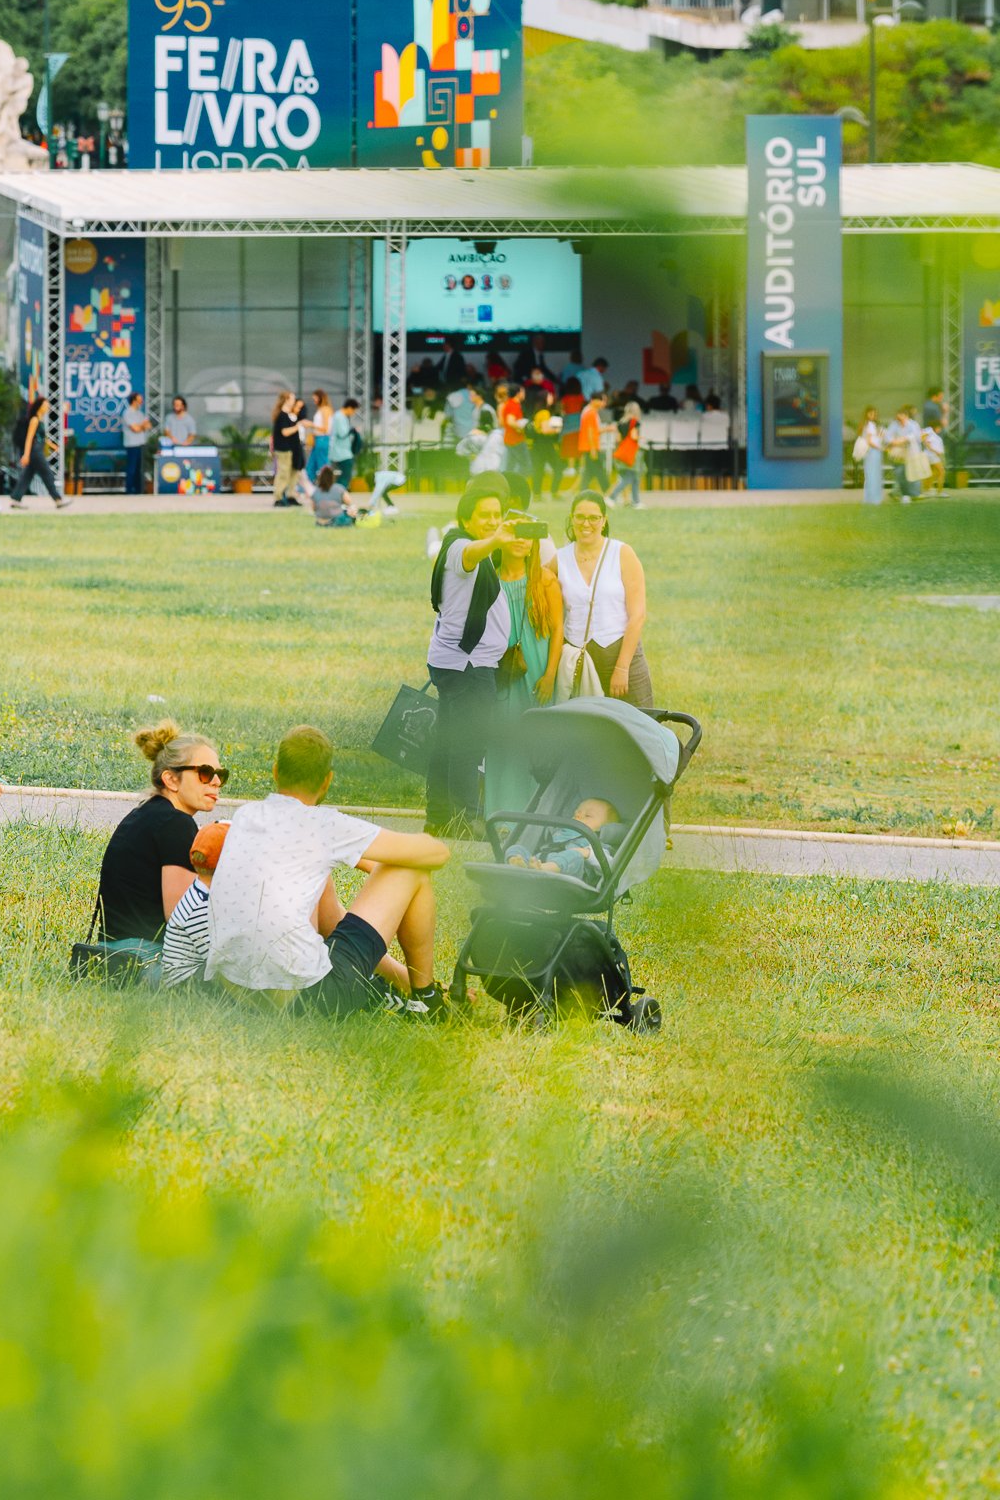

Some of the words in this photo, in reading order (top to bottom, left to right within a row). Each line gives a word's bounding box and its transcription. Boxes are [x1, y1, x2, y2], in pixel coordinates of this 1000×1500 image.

[155, 36, 315, 94] FEIRA
[155, 90, 321, 151] LIVRO
[796, 136, 827, 208] SUL
[760, 137, 795, 349] AUDITÓRIO
[84, 416, 123, 433] 202
